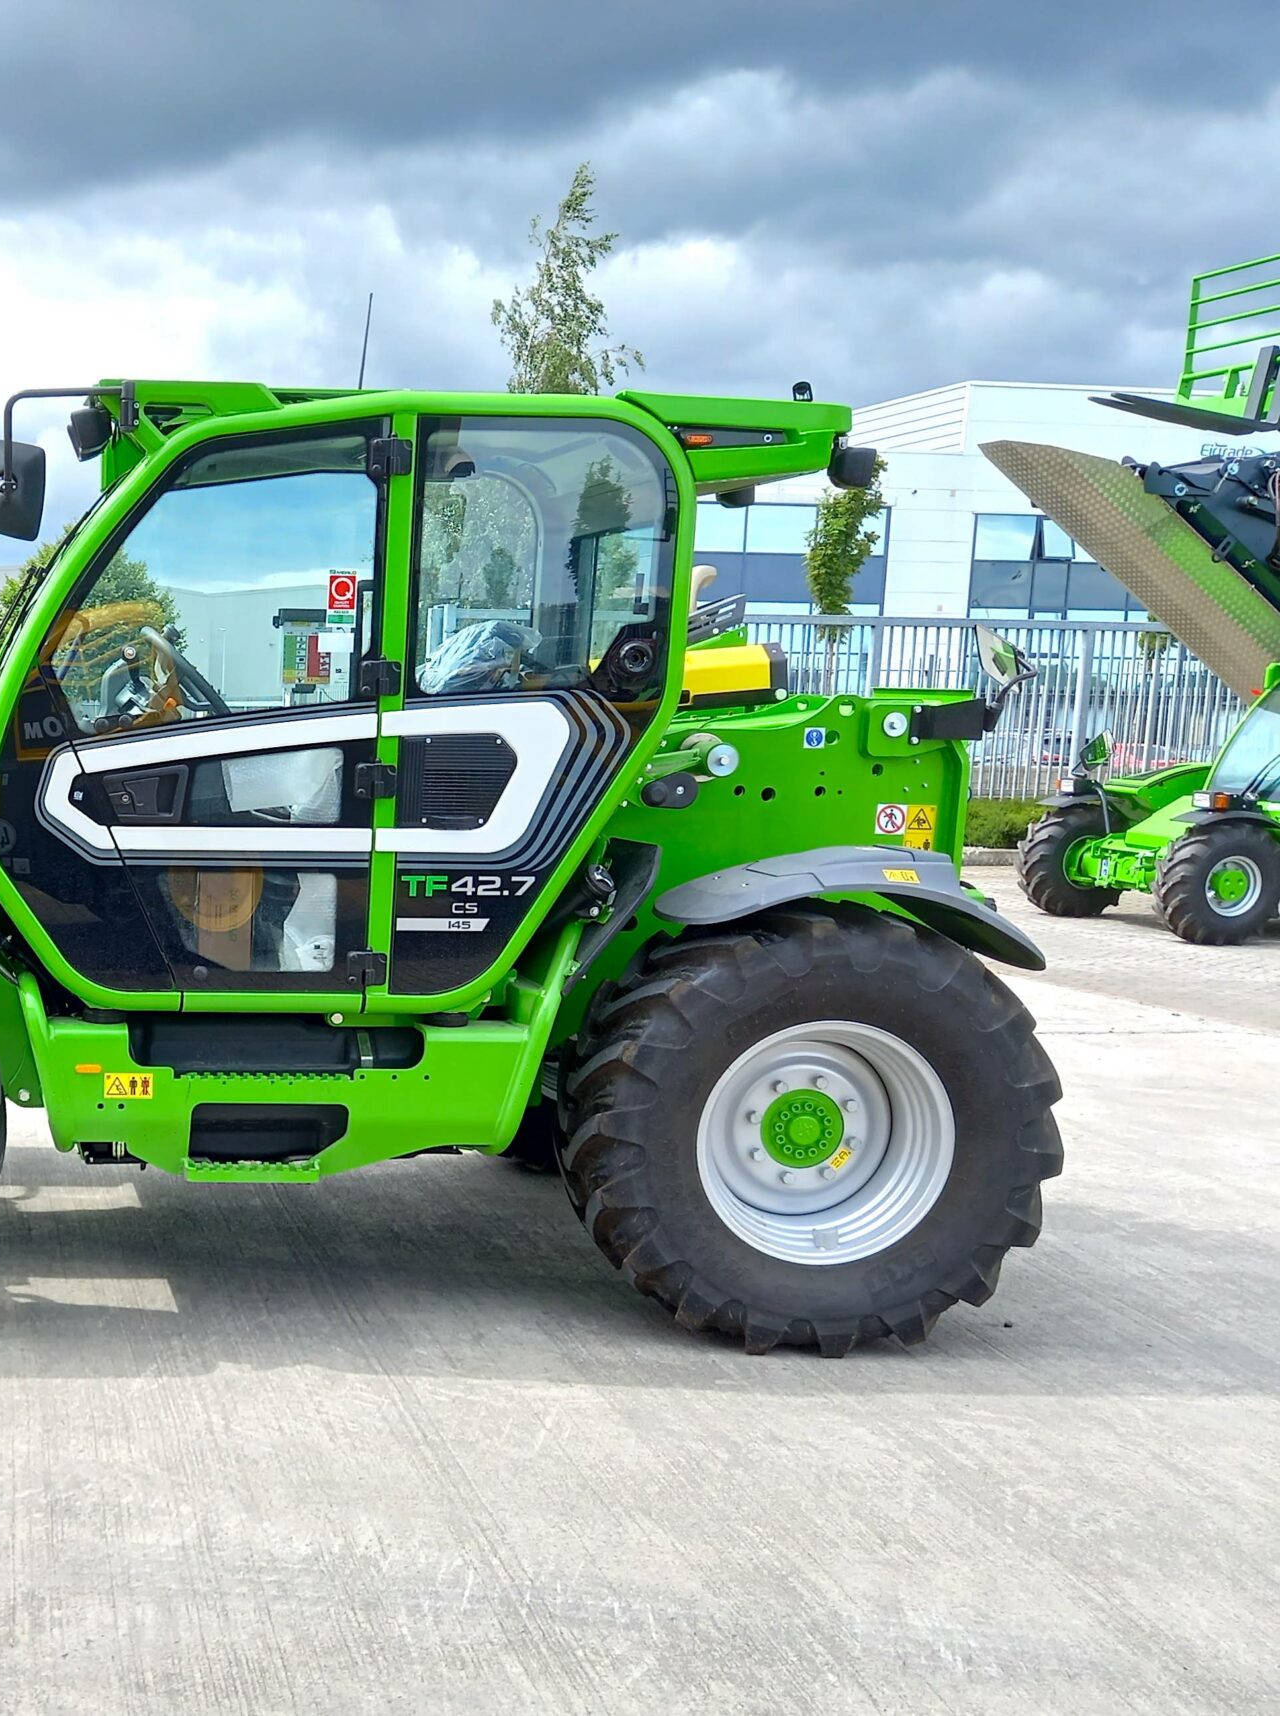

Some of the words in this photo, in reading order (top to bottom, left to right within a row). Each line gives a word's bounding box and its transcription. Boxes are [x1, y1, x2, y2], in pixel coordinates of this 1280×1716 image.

[331, 577, 353, 601] Q
[401, 875, 536, 897] TF42.7
[451, 902, 478, 914] CS
[448, 920, 472, 929] 145
